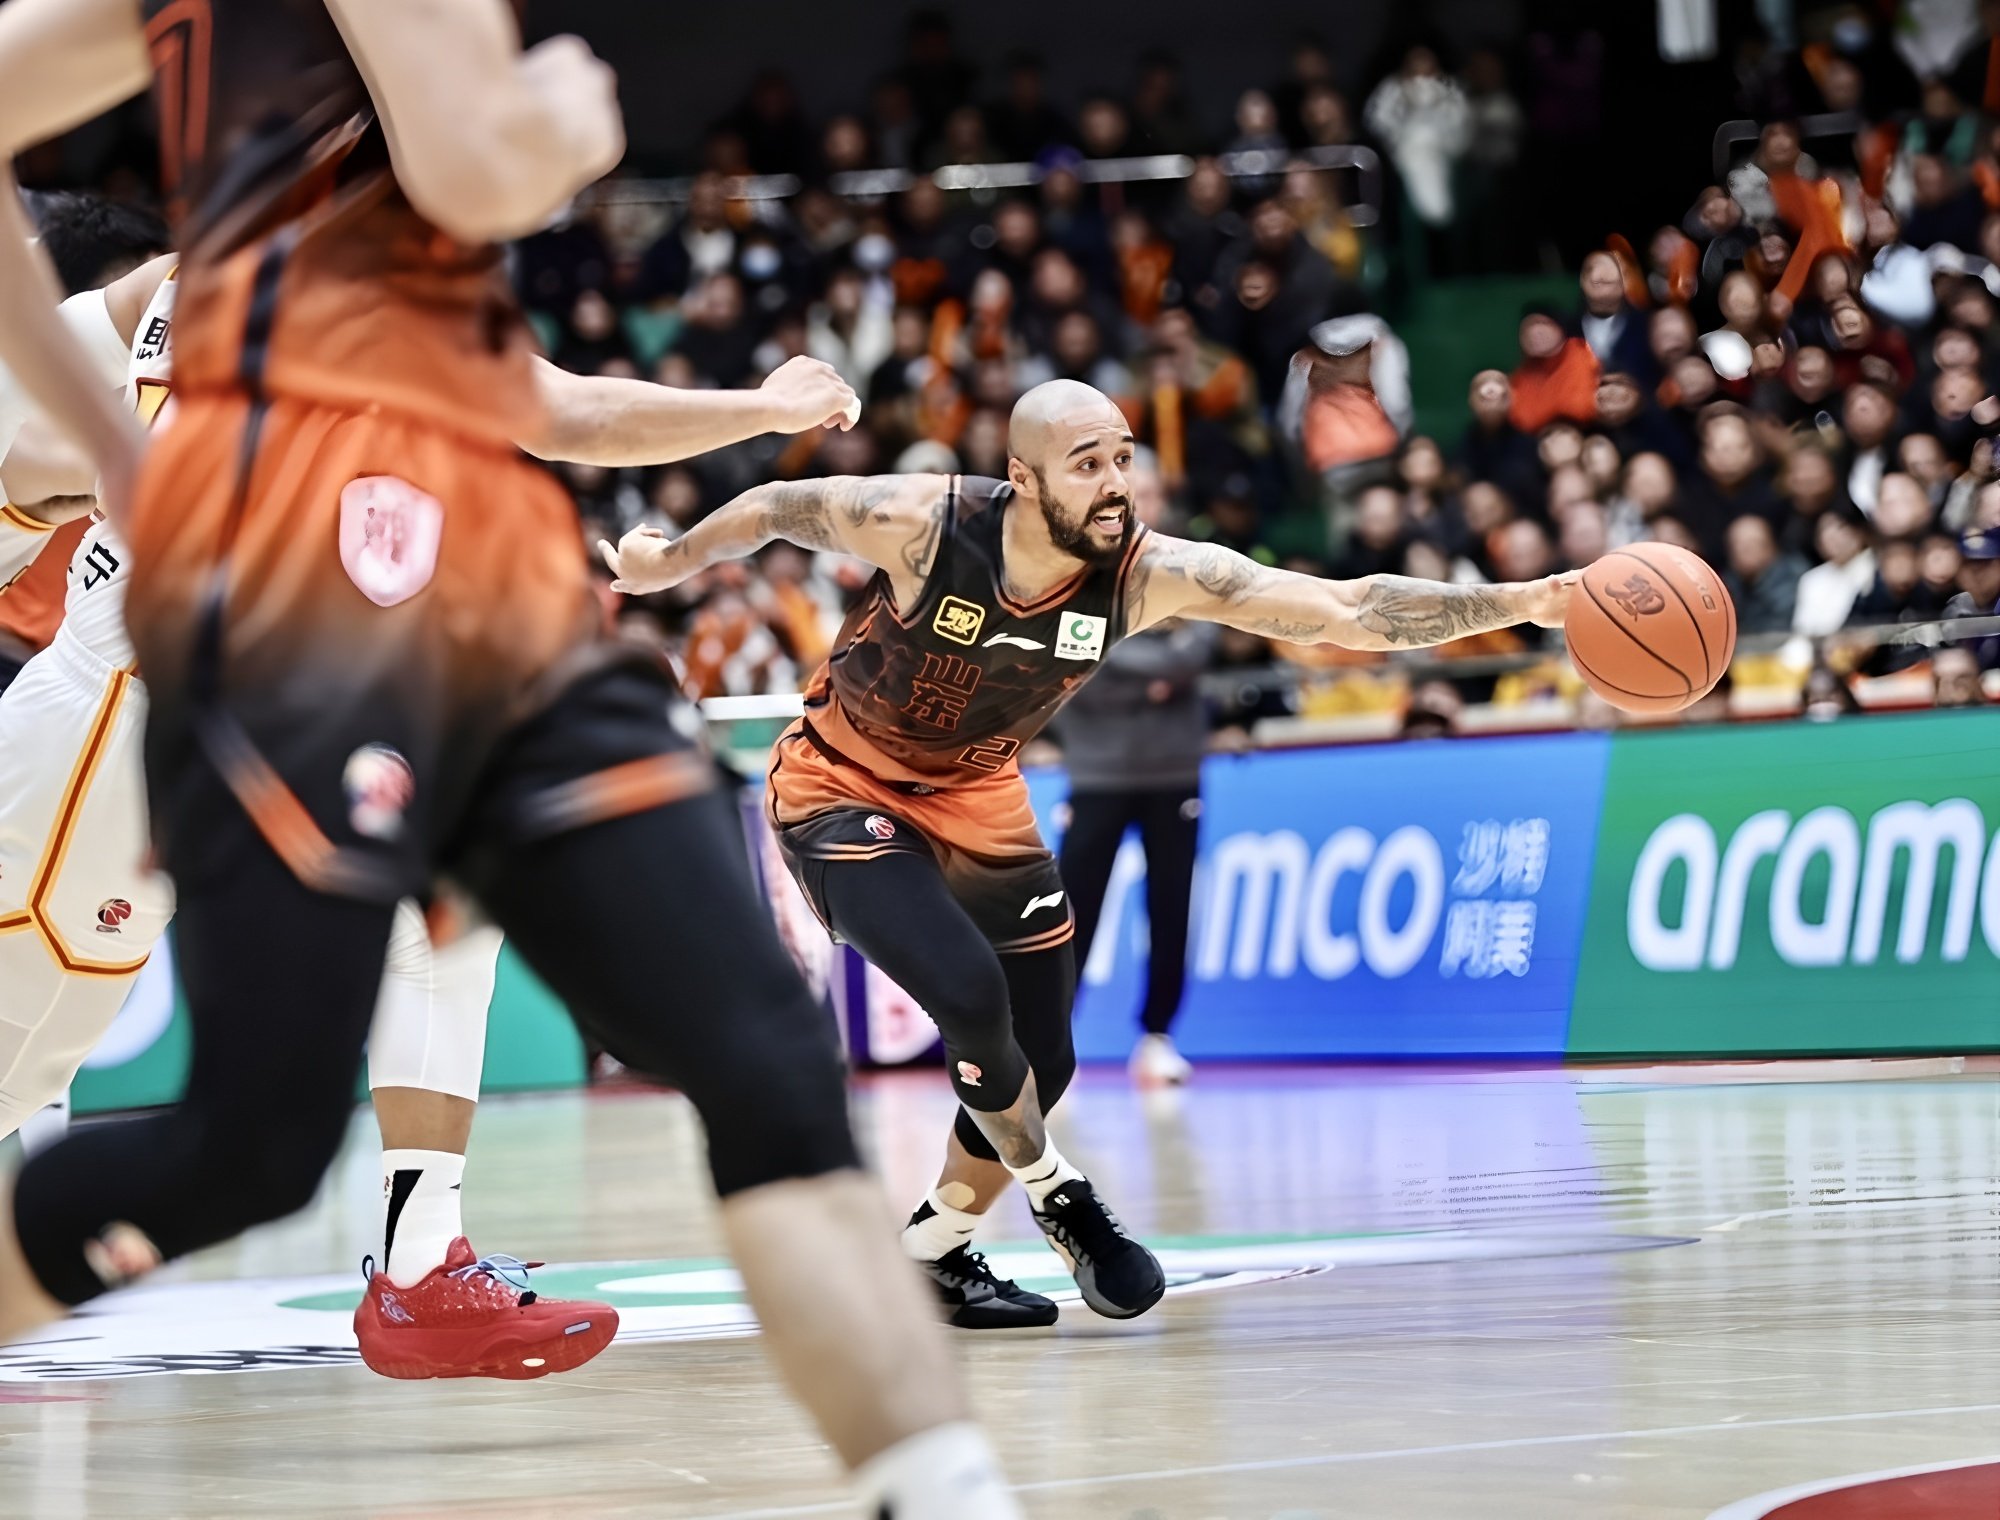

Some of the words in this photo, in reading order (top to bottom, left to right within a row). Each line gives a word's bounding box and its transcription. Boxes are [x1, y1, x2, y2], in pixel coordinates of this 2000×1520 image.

[901, 652, 982, 731] 山东
[955, 736, 1020, 773] 2
[1627, 797, 2000, 971] aram
